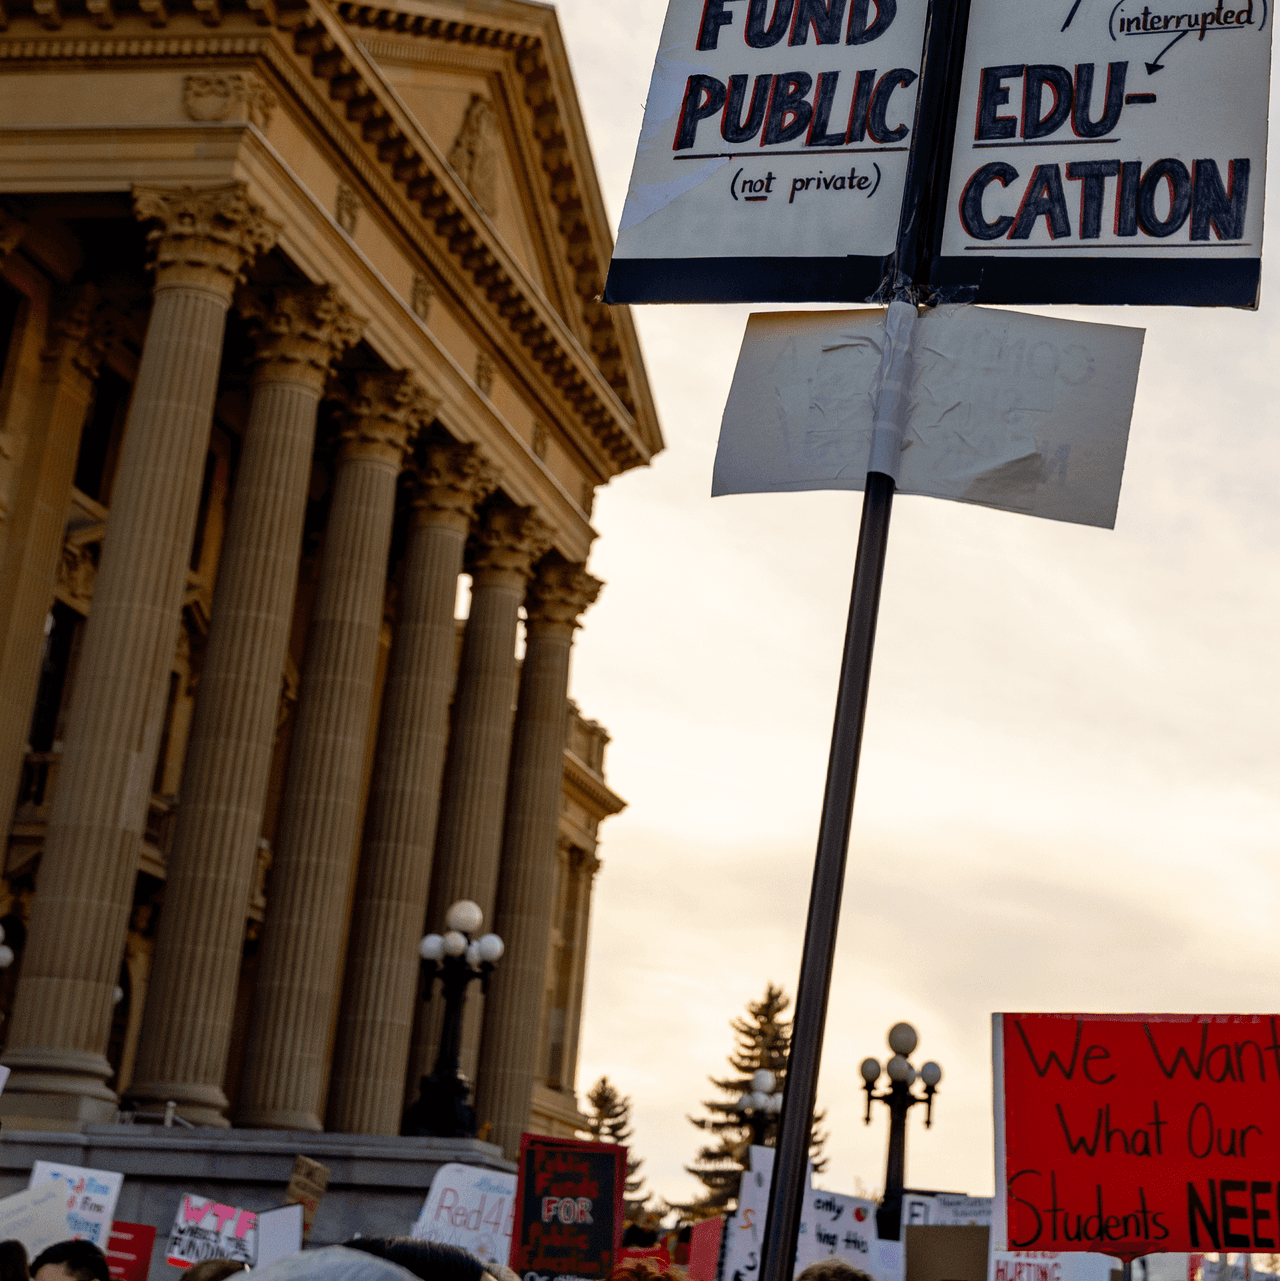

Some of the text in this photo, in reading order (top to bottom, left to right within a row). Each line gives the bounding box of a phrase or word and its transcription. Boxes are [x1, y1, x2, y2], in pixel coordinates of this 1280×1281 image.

[672, 61, 1157, 151] PUBLIC EDU-
[730, 162, 882, 204] (not private)
[958, 157, 1251, 243] CATION
[1014, 1019, 1117, 1085] We
[1055, 1100, 1263, 1159] What Our
[183, 1195, 258, 1239] WTF
[541, 1196, 595, 1224] FOR
[1007, 1169, 1169, 1248] Students
